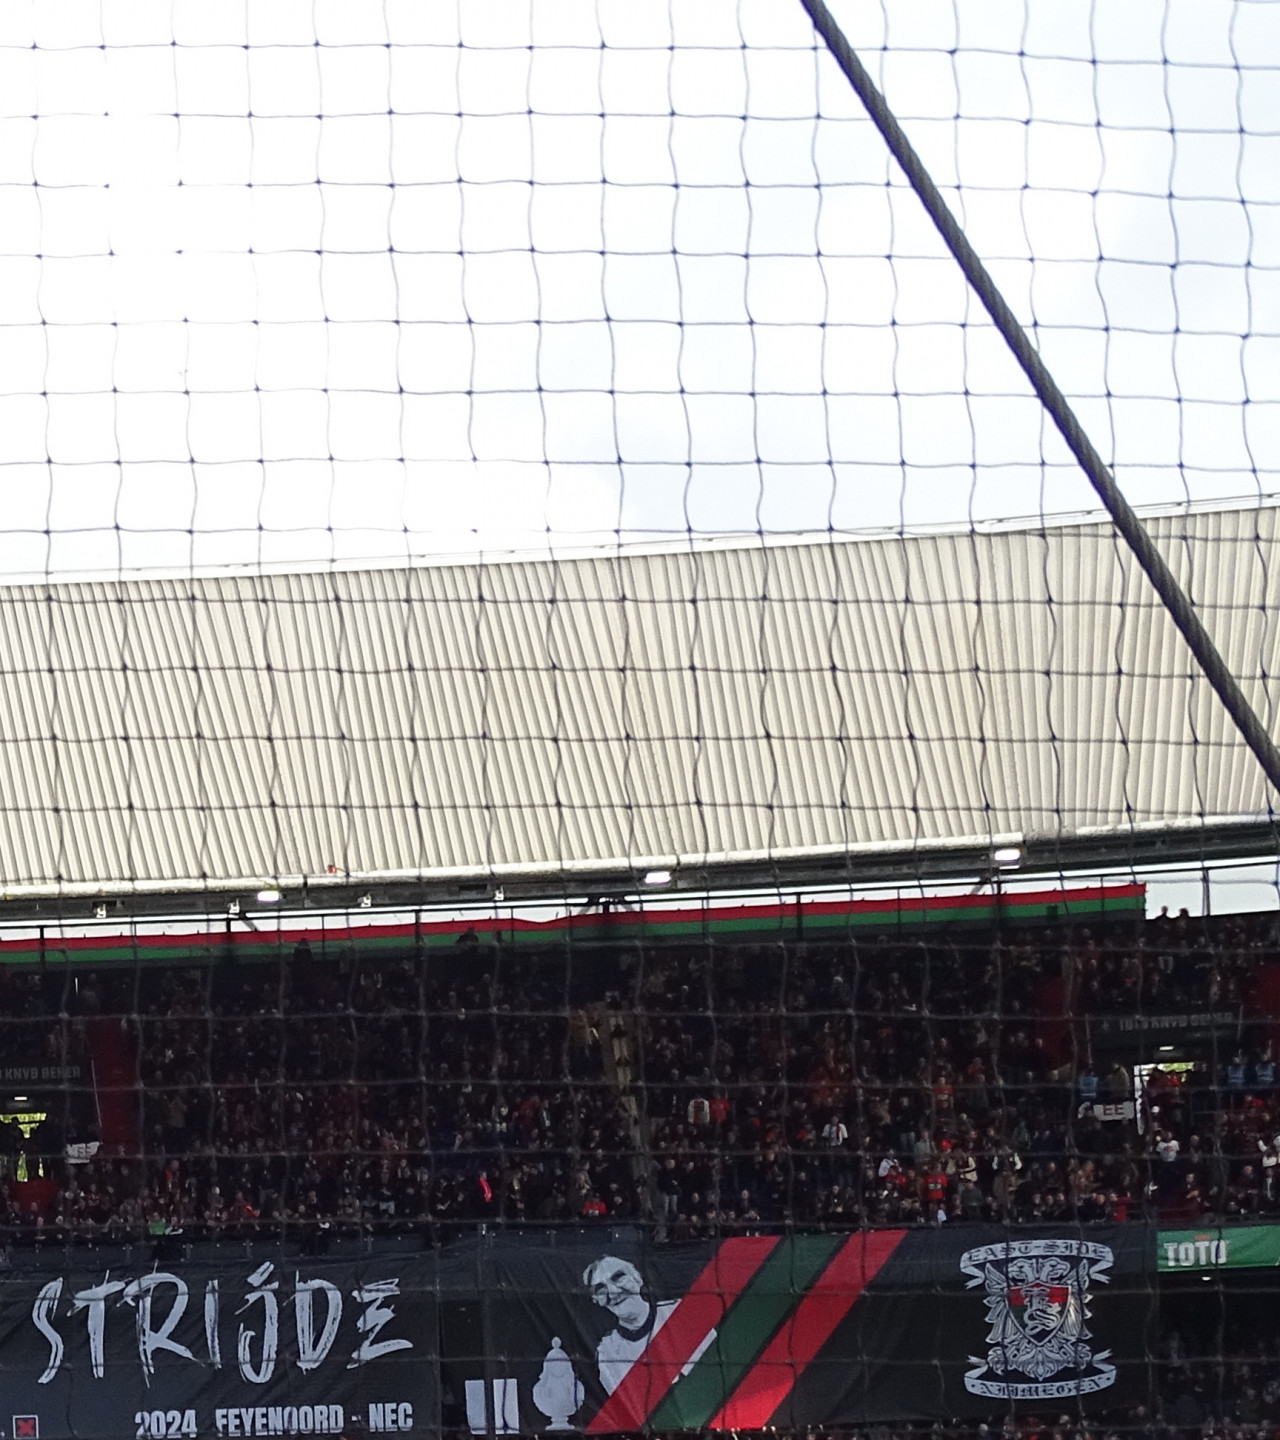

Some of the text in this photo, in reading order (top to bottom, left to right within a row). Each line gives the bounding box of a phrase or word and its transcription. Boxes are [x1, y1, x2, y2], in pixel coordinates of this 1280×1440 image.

[5, 1067, 39, 1080] KNVB
[1164, 1240, 1227, 1266] TOTO
[33, 1261, 414, 1388] STRIJDE
[135, 1409, 198, 1440] 2024
[215, 1404, 344, 1438] FEYENOORD
[368, 1402, 414, 1432] NEC
